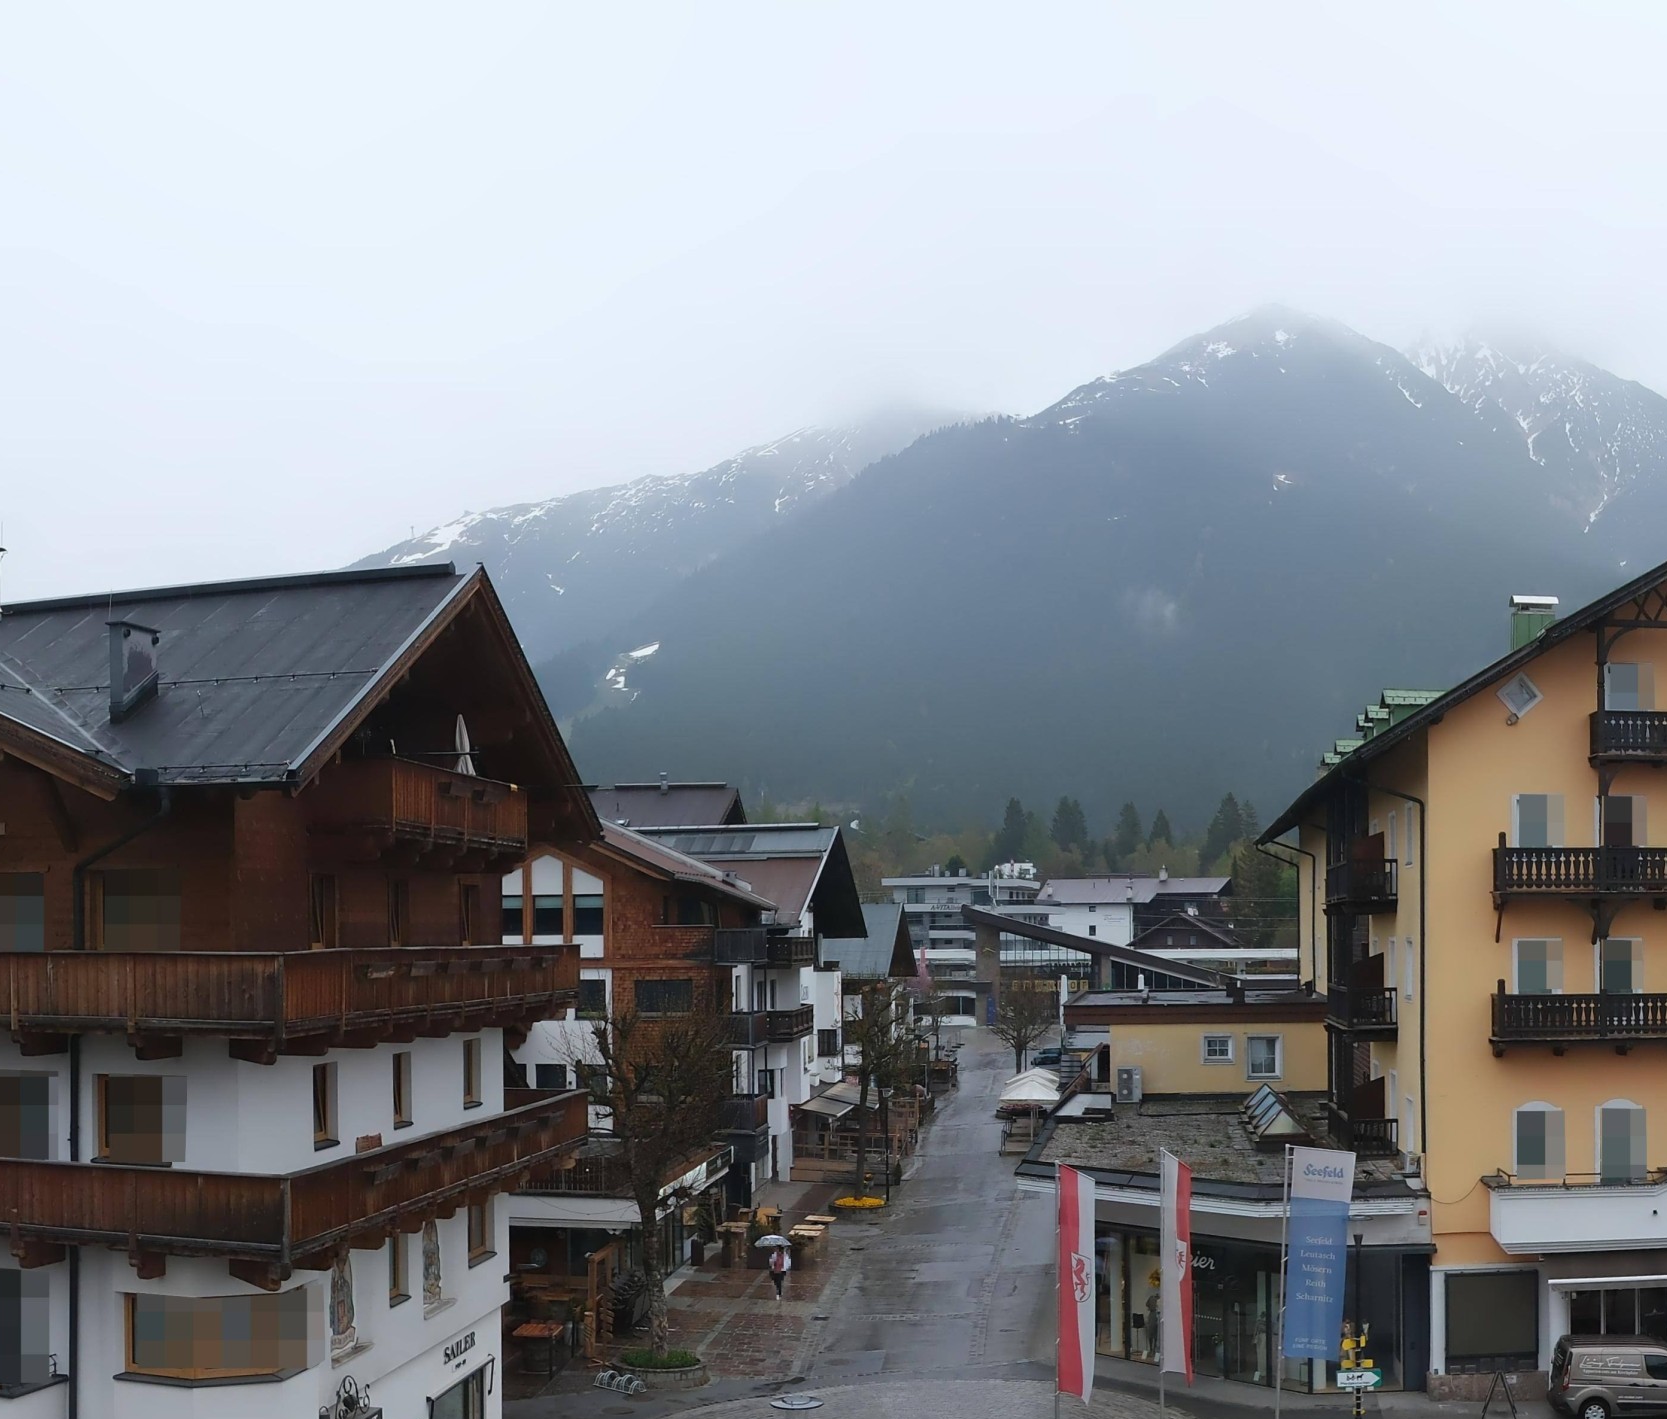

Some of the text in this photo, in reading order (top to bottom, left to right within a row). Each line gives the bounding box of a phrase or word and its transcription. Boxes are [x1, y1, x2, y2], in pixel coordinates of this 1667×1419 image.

[1304, 1163, 1344, 1179] Seefeld
[1306, 1235, 1332, 1245] Seefeld
[1191, 1250, 1215, 1269] ier
[1300, 1249, 1336, 1260] Leutasch
[1301, 1263, 1332, 1274] Mösern
[1305, 1279, 1326, 1288] Reith
[1296, 1292, 1333, 1303] Scharnitz
[443, 1331, 476, 1365] SAILER
